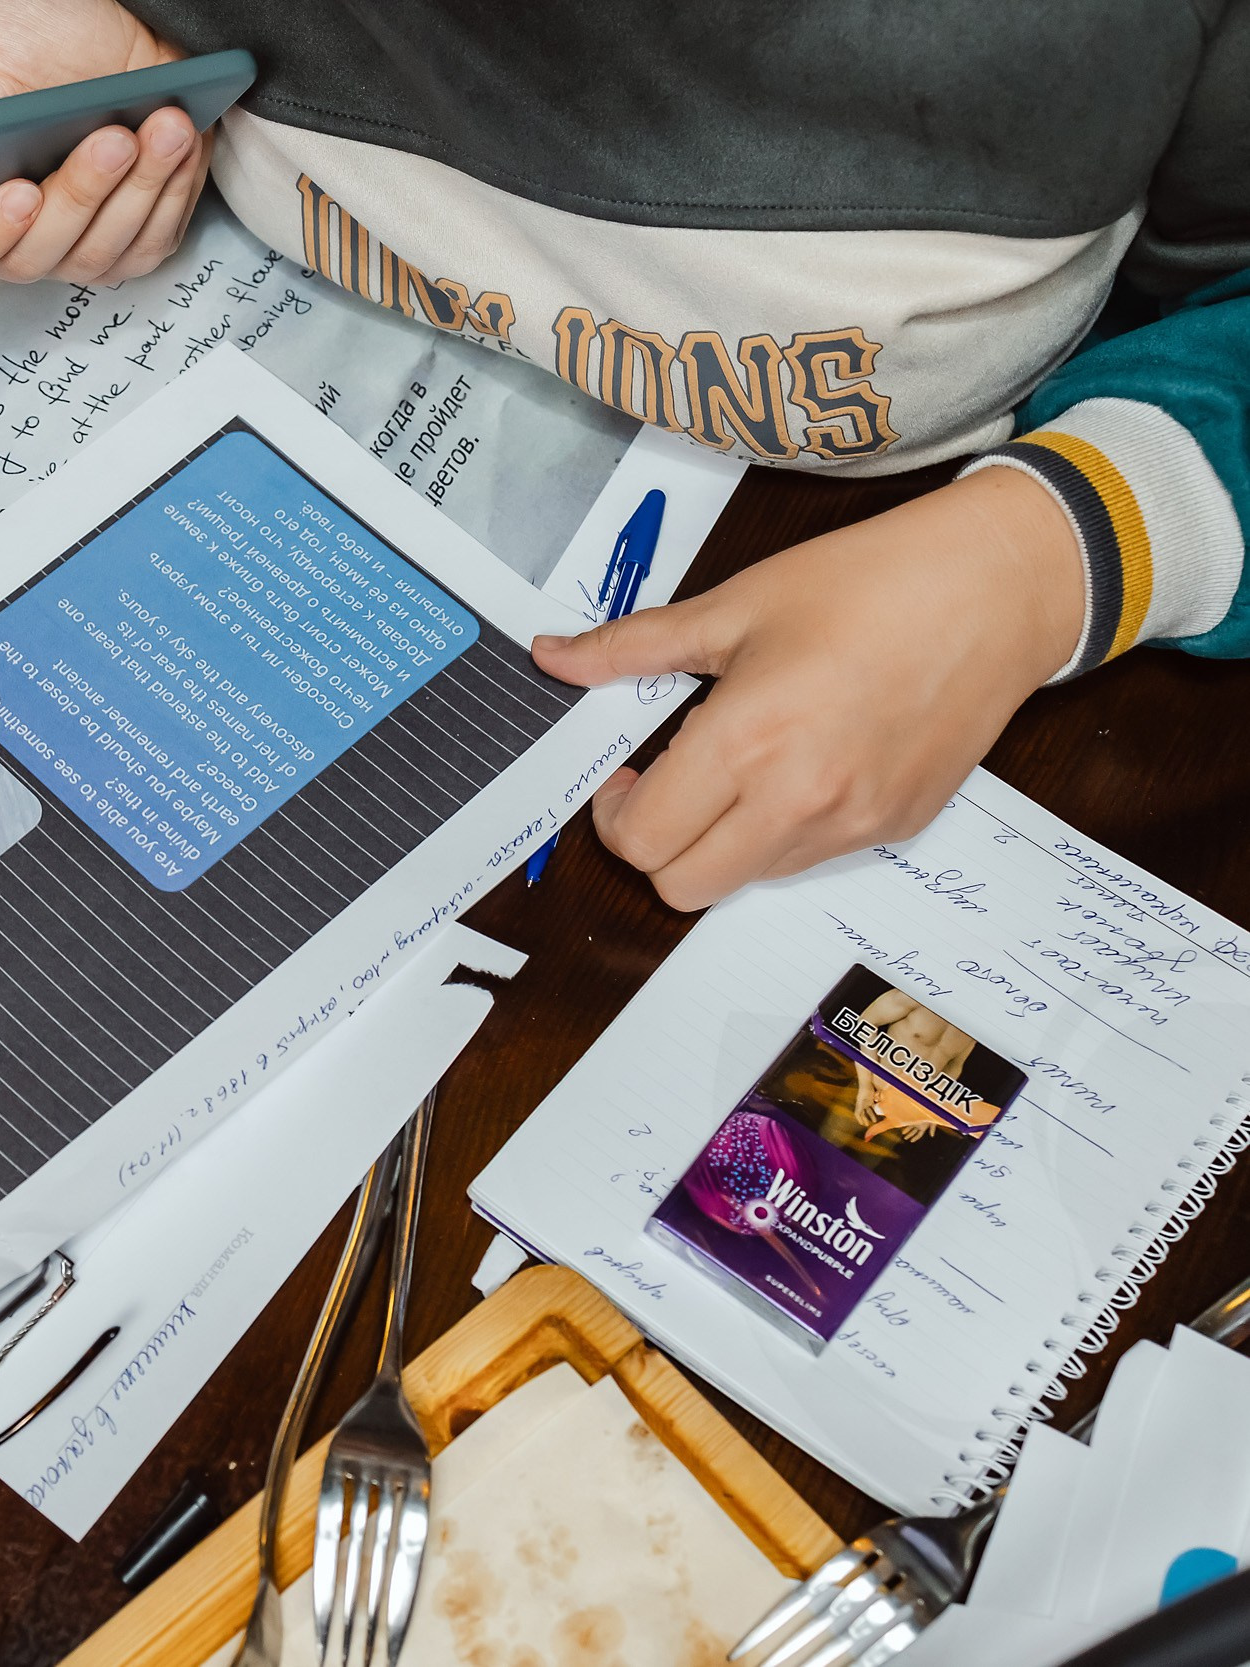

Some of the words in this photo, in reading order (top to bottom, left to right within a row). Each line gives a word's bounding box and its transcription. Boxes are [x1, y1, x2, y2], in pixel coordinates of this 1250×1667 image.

[44, 282, 96, 339] most
[81, 380, 131, 415] the
[123, 318, 174, 371] park
[10, 415, 40, 439] to
[37, 355, 89, 405] find
[306, 380, 341, 416] ий
[368, 397, 416, 459] когда
[408, 380, 427, 399] в
[409, 373, 472, 462] пройдет
[164, 504, 207, 542] земле
[187, 499, 248, 550] Греции?
[216, 491, 260, 526] носит
[273, 509, 299, 530] его
[299, 500, 335, 533] твоё.
[206, 541, 219, 552] к
[259, 525, 282, 548] что
[298, 527, 326, 553] год
[336, 532, 373, 563] небо
[150, 552, 198, 594] узреть
[217, 551, 263, 592] ближе
[243, 546, 311, 597] древней
[287, 545, 363, 611] астероиду,
[371, 561, 385, 572] и
[57, 598, 84, 622] one
[118, 588, 159, 626] yours.
[193, 591, 230, 624] этом
[265, 589, 299, 622] быть
[307, 597, 319, 607] о
[365, 587, 388, 602] её
[388, 602, 409, 619] из
[394, 579, 463, 635] открытия
[116, 621, 136, 641] its
[217, 586, 328, 677] божественное?
[229, 623, 242, 634] в
[361, 609, 375, 621] к
[83, 621, 123, 659] bears
[130, 637, 152, 651] of
[155, 625, 171, 640] is
[168, 637, 195, 659] sky
[239, 632, 261, 651] ты
[297, 620, 341, 653] стоит
[321, 607, 398, 671] вспомнить
[376, 619, 432, 666] Добавь
[409, 618, 446, 650] одно
[0, 641, 23, 664] the
[120, 654, 150, 683] that
[150, 652, 186, 680] year
[260, 649, 284, 667] ли
[22, 662, 38, 679] to
[52, 658, 104, 705] ancient
[195, 659, 220, 682] the
[340, 654, 392, 698] Может
[396, 669, 410, 681] и
[36, 677, 80, 715] closer
[146, 680, 206, 731] asteroid
[182, 678, 207, 702] the
[215, 679, 248, 704] and
[281, 665, 353, 728] Способен
[328, 675, 373, 712] нечто
[79, 714, 100, 736] be
[101, 705, 174, 768] remember
[206, 699, 254, 741] names
[245, 703, 314, 760] discovery
[95, 732, 146, 775] should
[206, 730, 230, 754] the
[252, 741, 280, 765] her
[53, 758, 81, 784] see
[231, 751, 248, 769] to
[274, 762, 296, 776] of
[80, 783, 96, 801] to
[104, 777, 142, 810] this?
[144, 774, 176, 800] you
[168, 766, 201, 792] and
[196, 760, 257, 811] Greece?
[243, 765, 279, 792] Add
[96, 798, 128, 827] able
[141, 806, 158, 824] in
[172, 799, 221, 845] Maybe
[200, 791, 239, 825] earth
[126, 825, 158, 853] you
[157, 820, 200, 859] divine
[154, 851, 182, 876] Are
[830, 1005, 985, 1117] БЕЛСІЗДІК
[203, 1068, 248, 1113] 1868
[765, 1168, 875, 1265] Winston
[188, 1225, 254, 1297] Команда
[769, 1218, 855, 1280] EXPANDPURPLE
[764, 1273, 823, 1319] SUPERSLIMS
